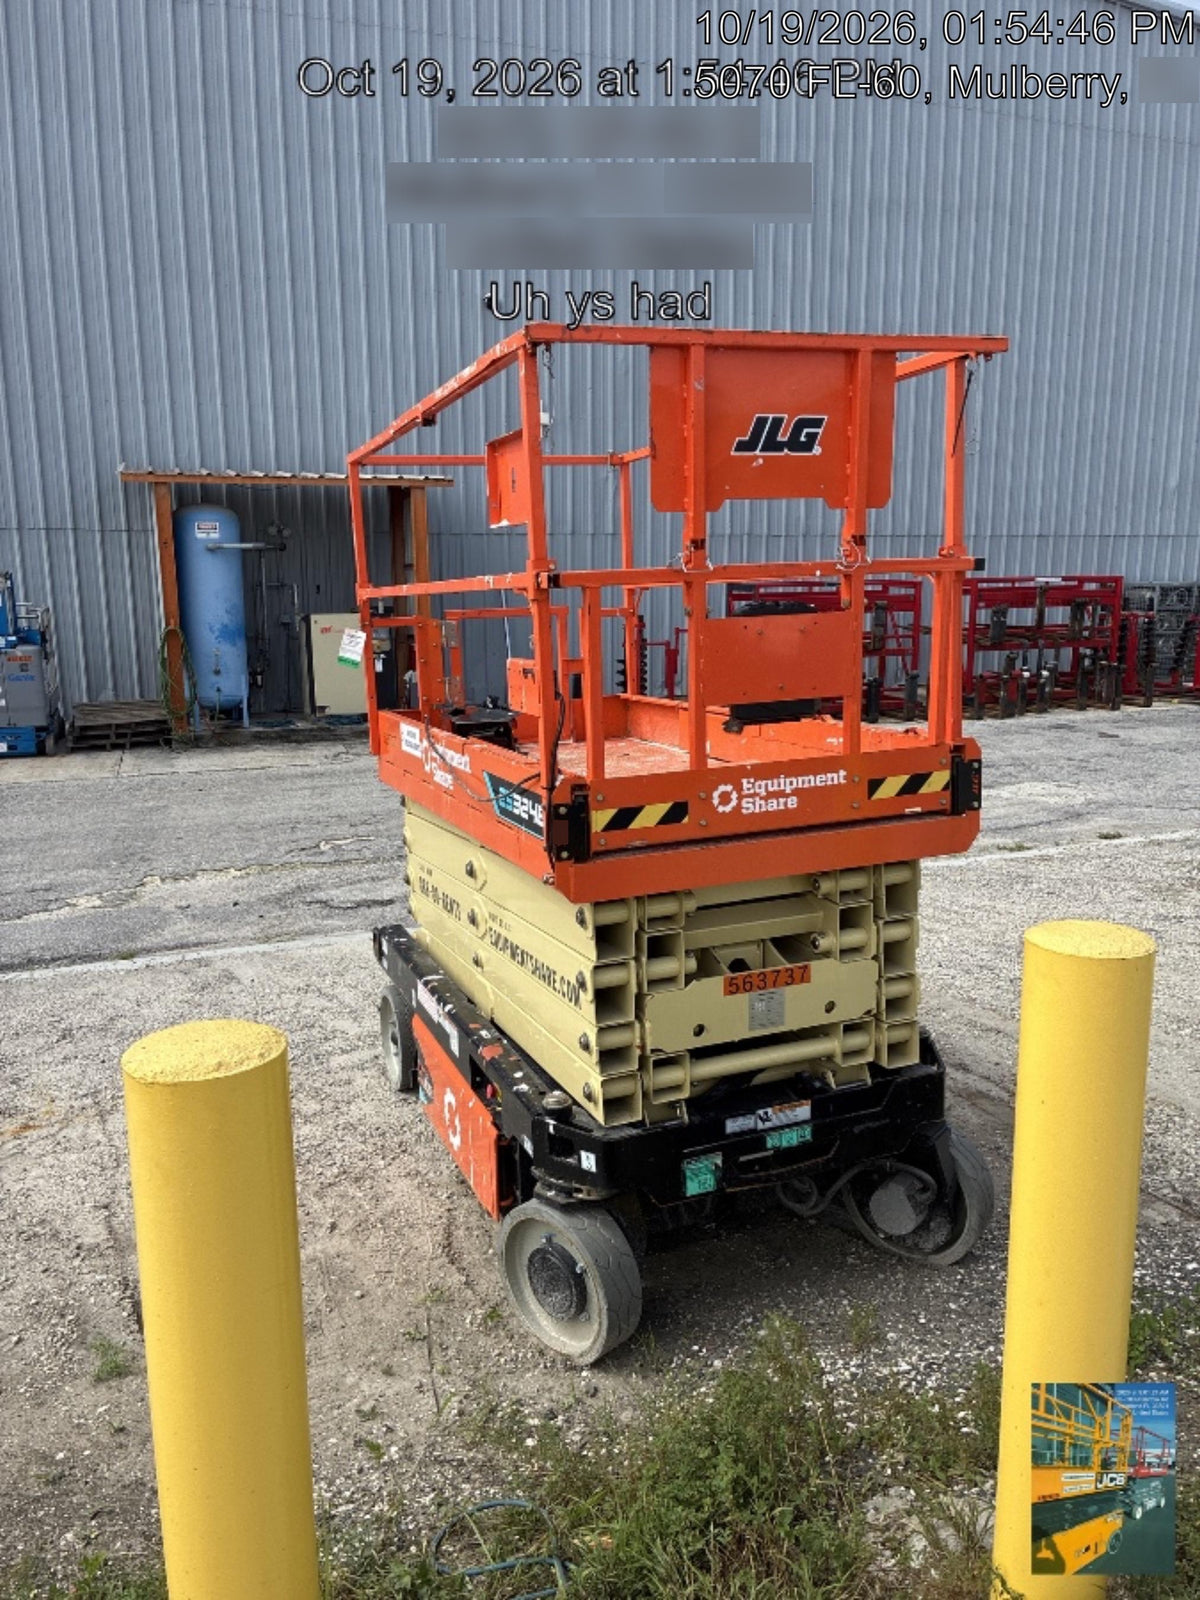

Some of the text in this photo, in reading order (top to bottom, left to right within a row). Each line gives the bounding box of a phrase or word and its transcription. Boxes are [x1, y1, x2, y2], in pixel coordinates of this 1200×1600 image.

[730, 414, 828, 456] JLG
[741, 769, 847, 796] Equipment
[741, 796, 798, 814] Share
[727, 964, 809, 995] 563737
